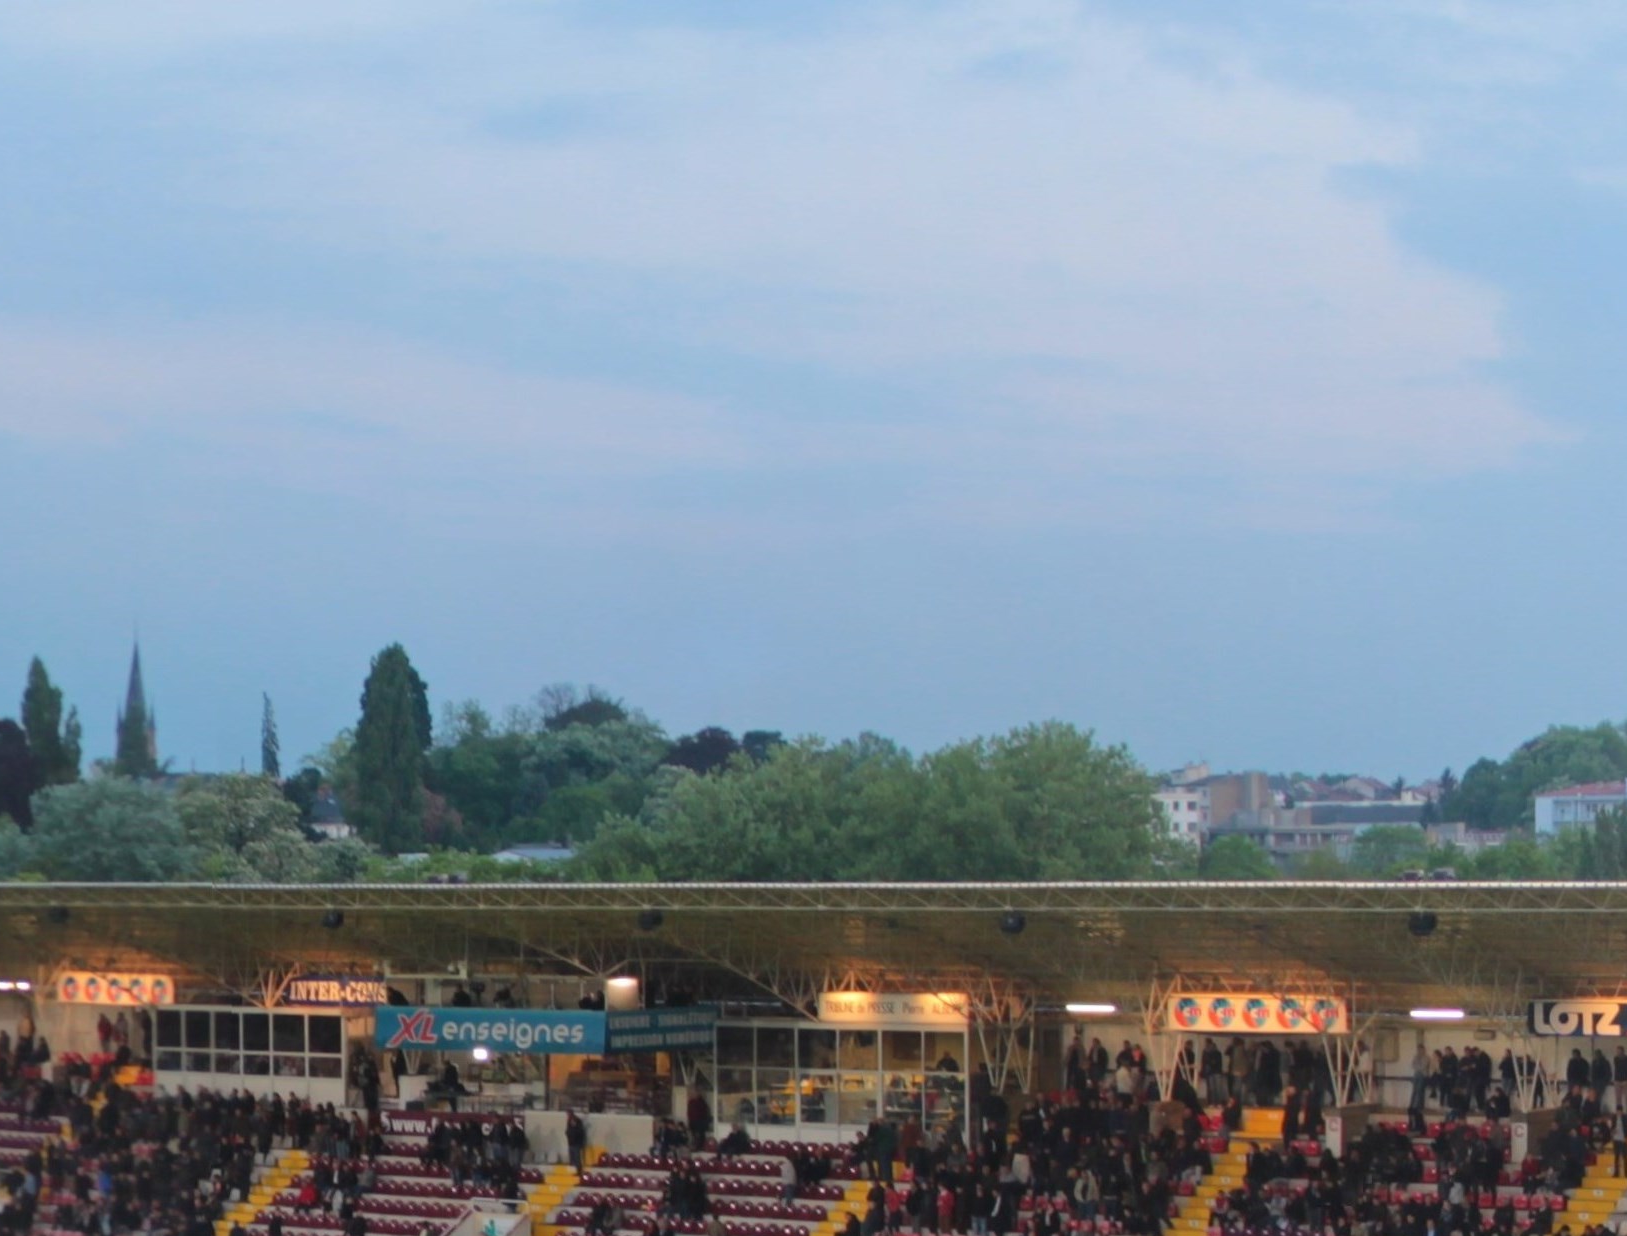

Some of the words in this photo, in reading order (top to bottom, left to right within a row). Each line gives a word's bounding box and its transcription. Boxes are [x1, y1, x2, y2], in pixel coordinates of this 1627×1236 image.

[386, 1008, 437, 1047] XL
[442, 1012, 584, 1048] enseignes
[1534, 1002, 1620, 1036] LOTZ
